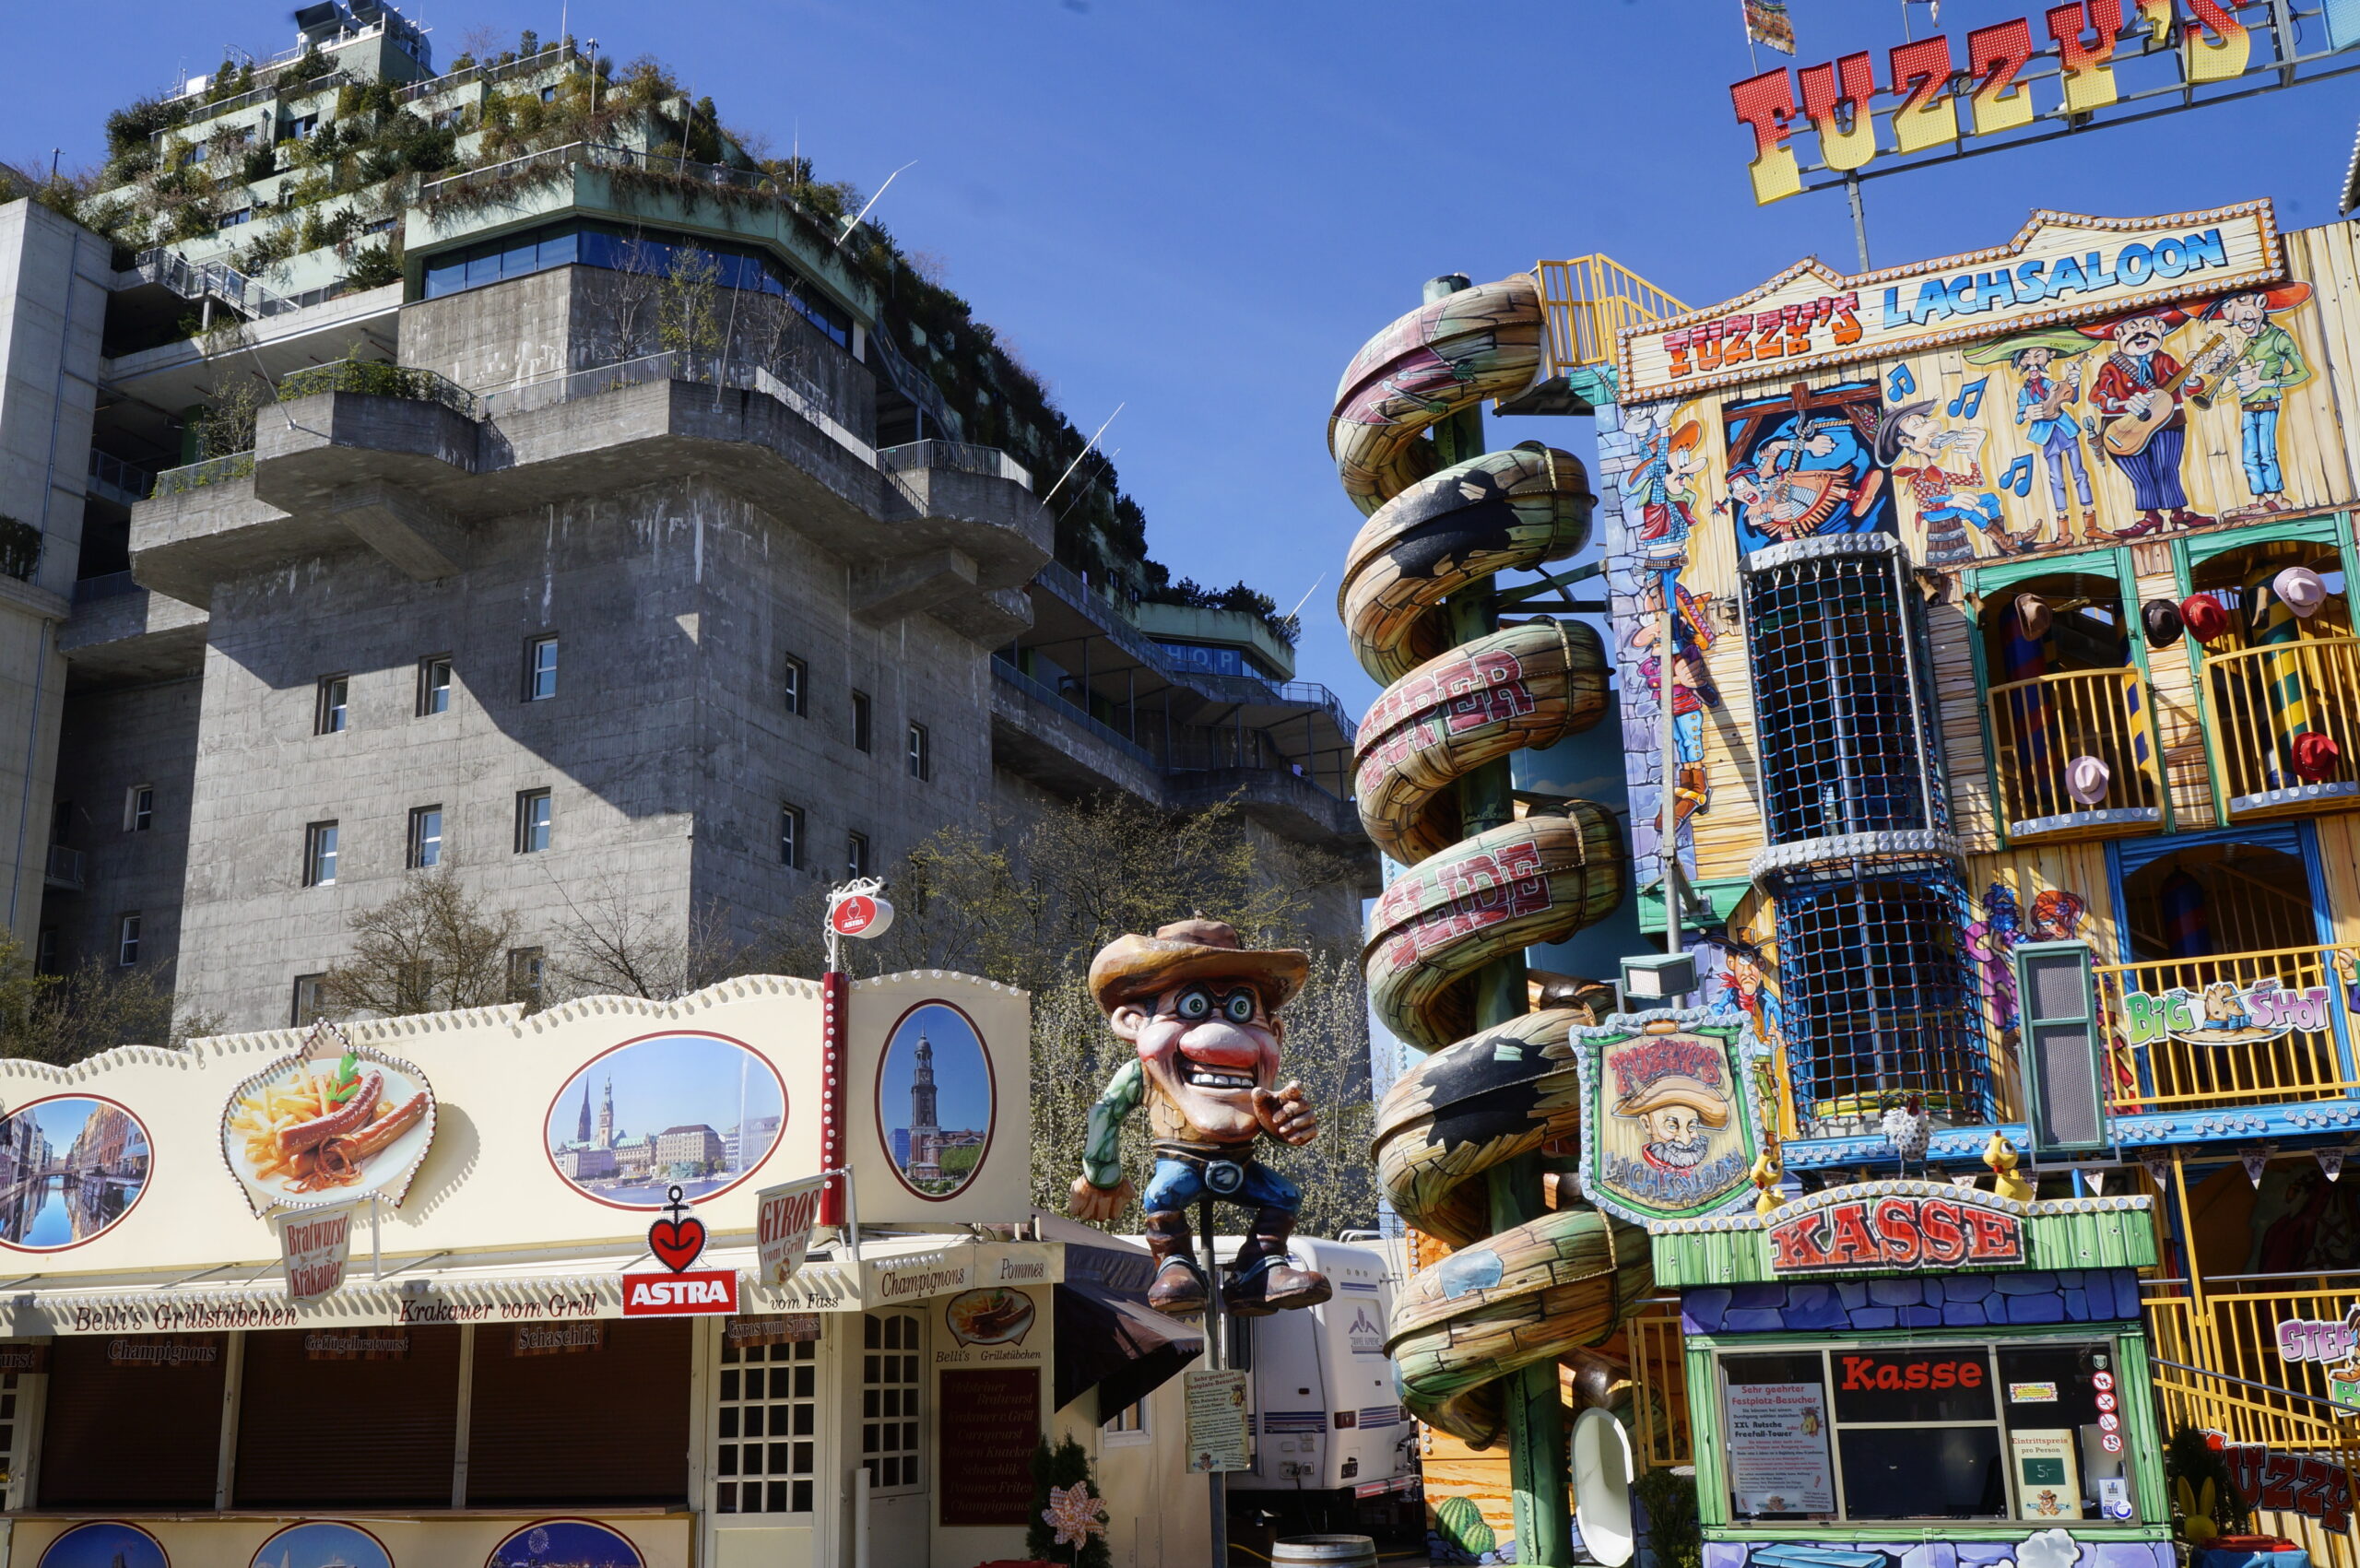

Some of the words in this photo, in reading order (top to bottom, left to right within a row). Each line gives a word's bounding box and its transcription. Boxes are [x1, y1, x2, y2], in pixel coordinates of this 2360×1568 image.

[1729, 0, 2250, 206] FUZZY'S
[1662, 291, 1861, 379] FUZZY'S
[1882, 227, 2229, 333] LACHSALOON
[1167, 644, 1233, 668] HOP
[1358, 648, 1537, 796] SUPER
[1379, 840, 1552, 973] SLIDE
[844, 918, 865, 928] ASTRA
[1609, 1039, 1721, 1096] FUZZY'S
[760, 1187, 820, 1244] GYROS
[286, 1212, 348, 1256] Bratwurst
[1771, 1199, 2024, 1270] KASSE
[763, 1249, 781, 1264] vom
[784, 1235, 805, 1257] Grill
[290, 1259, 343, 1297] Krakauer
[881, 1266, 965, 1298] Champignons
[1000, 1258, 1045, 1280] Pommes
[631, 1279, 729, 1306] ASTRA
[770, 1298, 801, 1310] vom
[807, 1292, 839, 1310] Fass
[75, 1305, 143, 1332] Belli's
[154, 1301, 300, 1328] Grillstübchen
[398, 1298, 494, 1324] Krakauer
[499, 1303, 543, 1320] vom
[548, 1292, 598, 1318] Grill
[518, 1324, 600, 1349] Schaschlik
[727, 1320, 761, 1341] Gyros
[761, 1321, 785, 1335] vom
[786, 1315, 820, 1336] Spiess
[107, 1339, 217, 1363] Champignons
[303, 1333, 409, 1352] Geflügelbratwurst
[2281, 1321, 2353, 1362] STEP
[936, 1350, 971, 1362] Belli's
[981, 1349, 1042, 1362] Grillstübchen
[1841, 1356, 1983, 1391] Kasse
[1732, 1396, 1817, 1407] Festplatz-Besucher
[1741, 1385, 1763, 1394] Sehr
[1765, 1385, 1805, 1395] geehrter
[958, 1428, 1023, 1443] Currywurst
[1735, 1430, 1793, 1438] Freefall-Tower
[1752, 1421, 1783, 1429] Rutsche
[2012, 1437, 2069, 1445] Eintrittspreis
